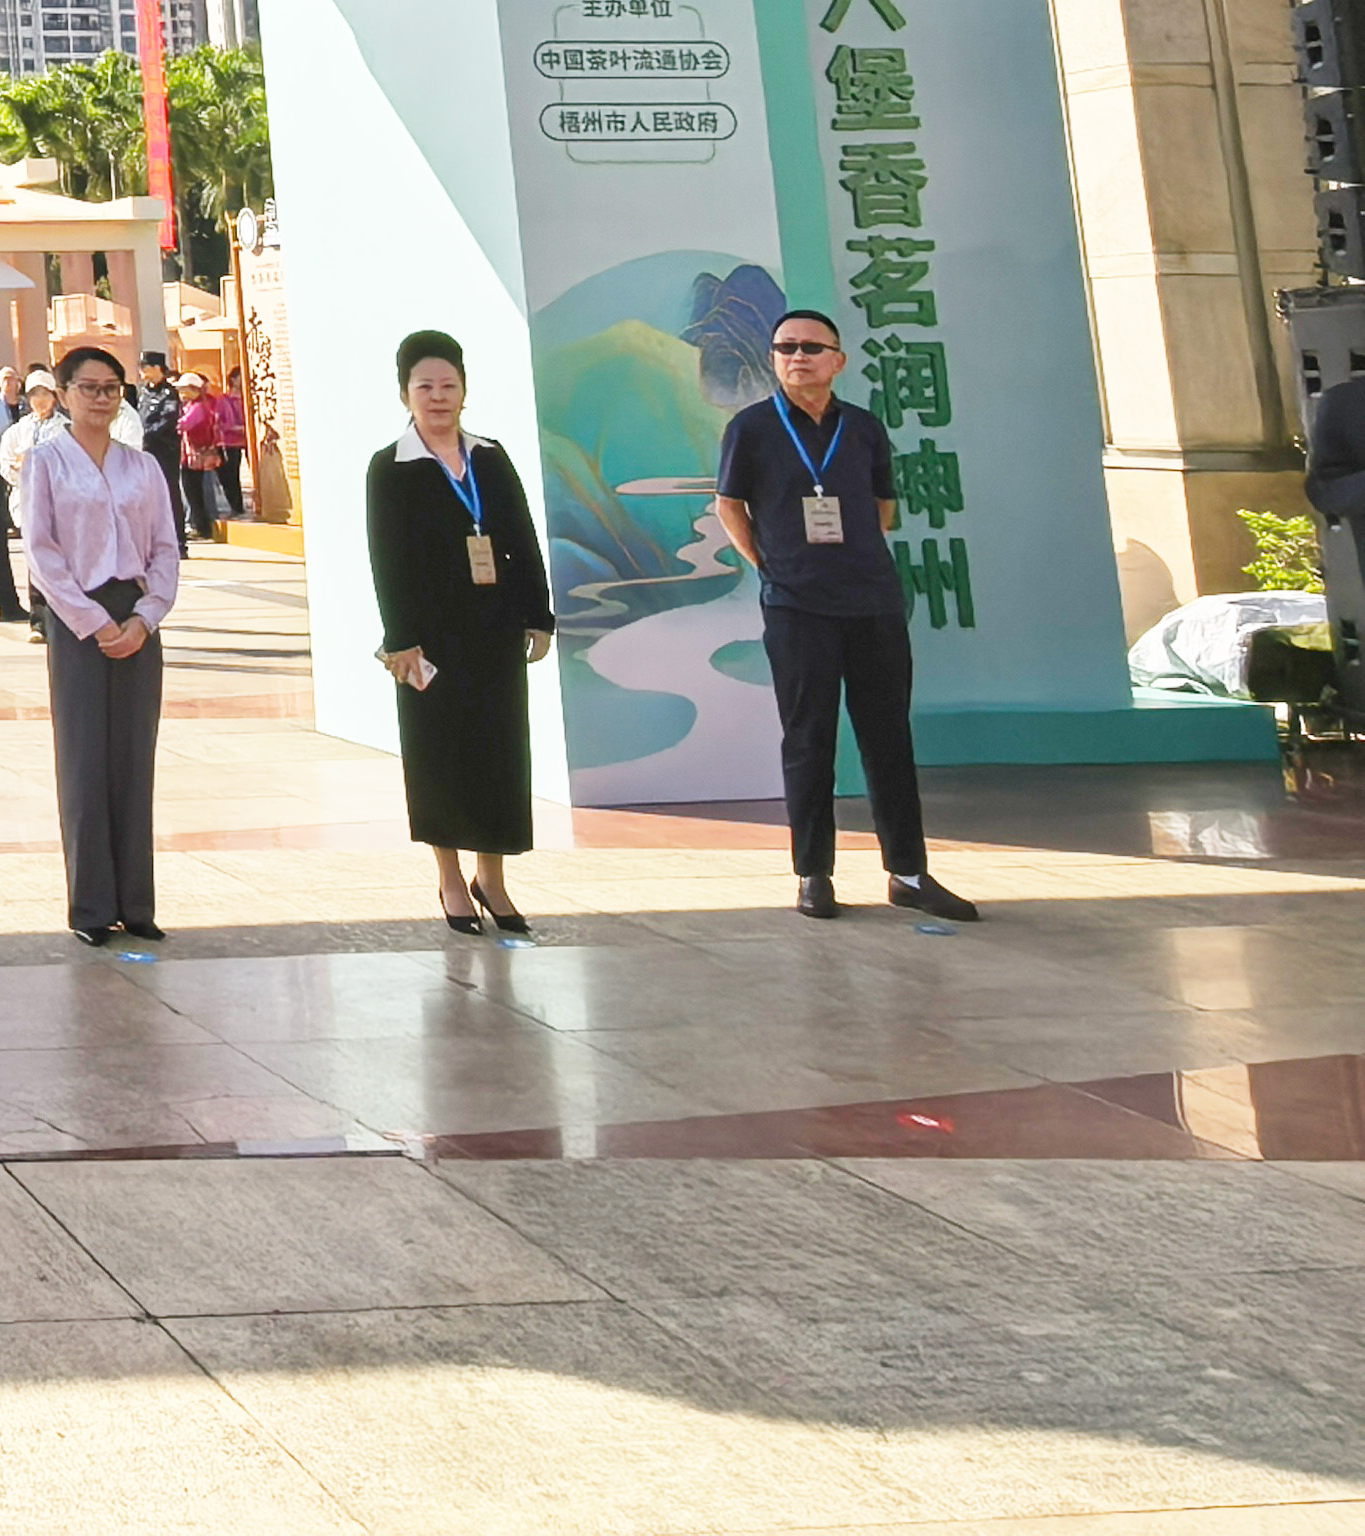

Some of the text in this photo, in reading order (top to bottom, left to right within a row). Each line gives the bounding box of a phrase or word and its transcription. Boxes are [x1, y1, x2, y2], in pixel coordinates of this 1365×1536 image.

[541, 49, 723, 72] 中国茶叶流通协会
[558, 110, 719, 134] 梧州市人民政府
